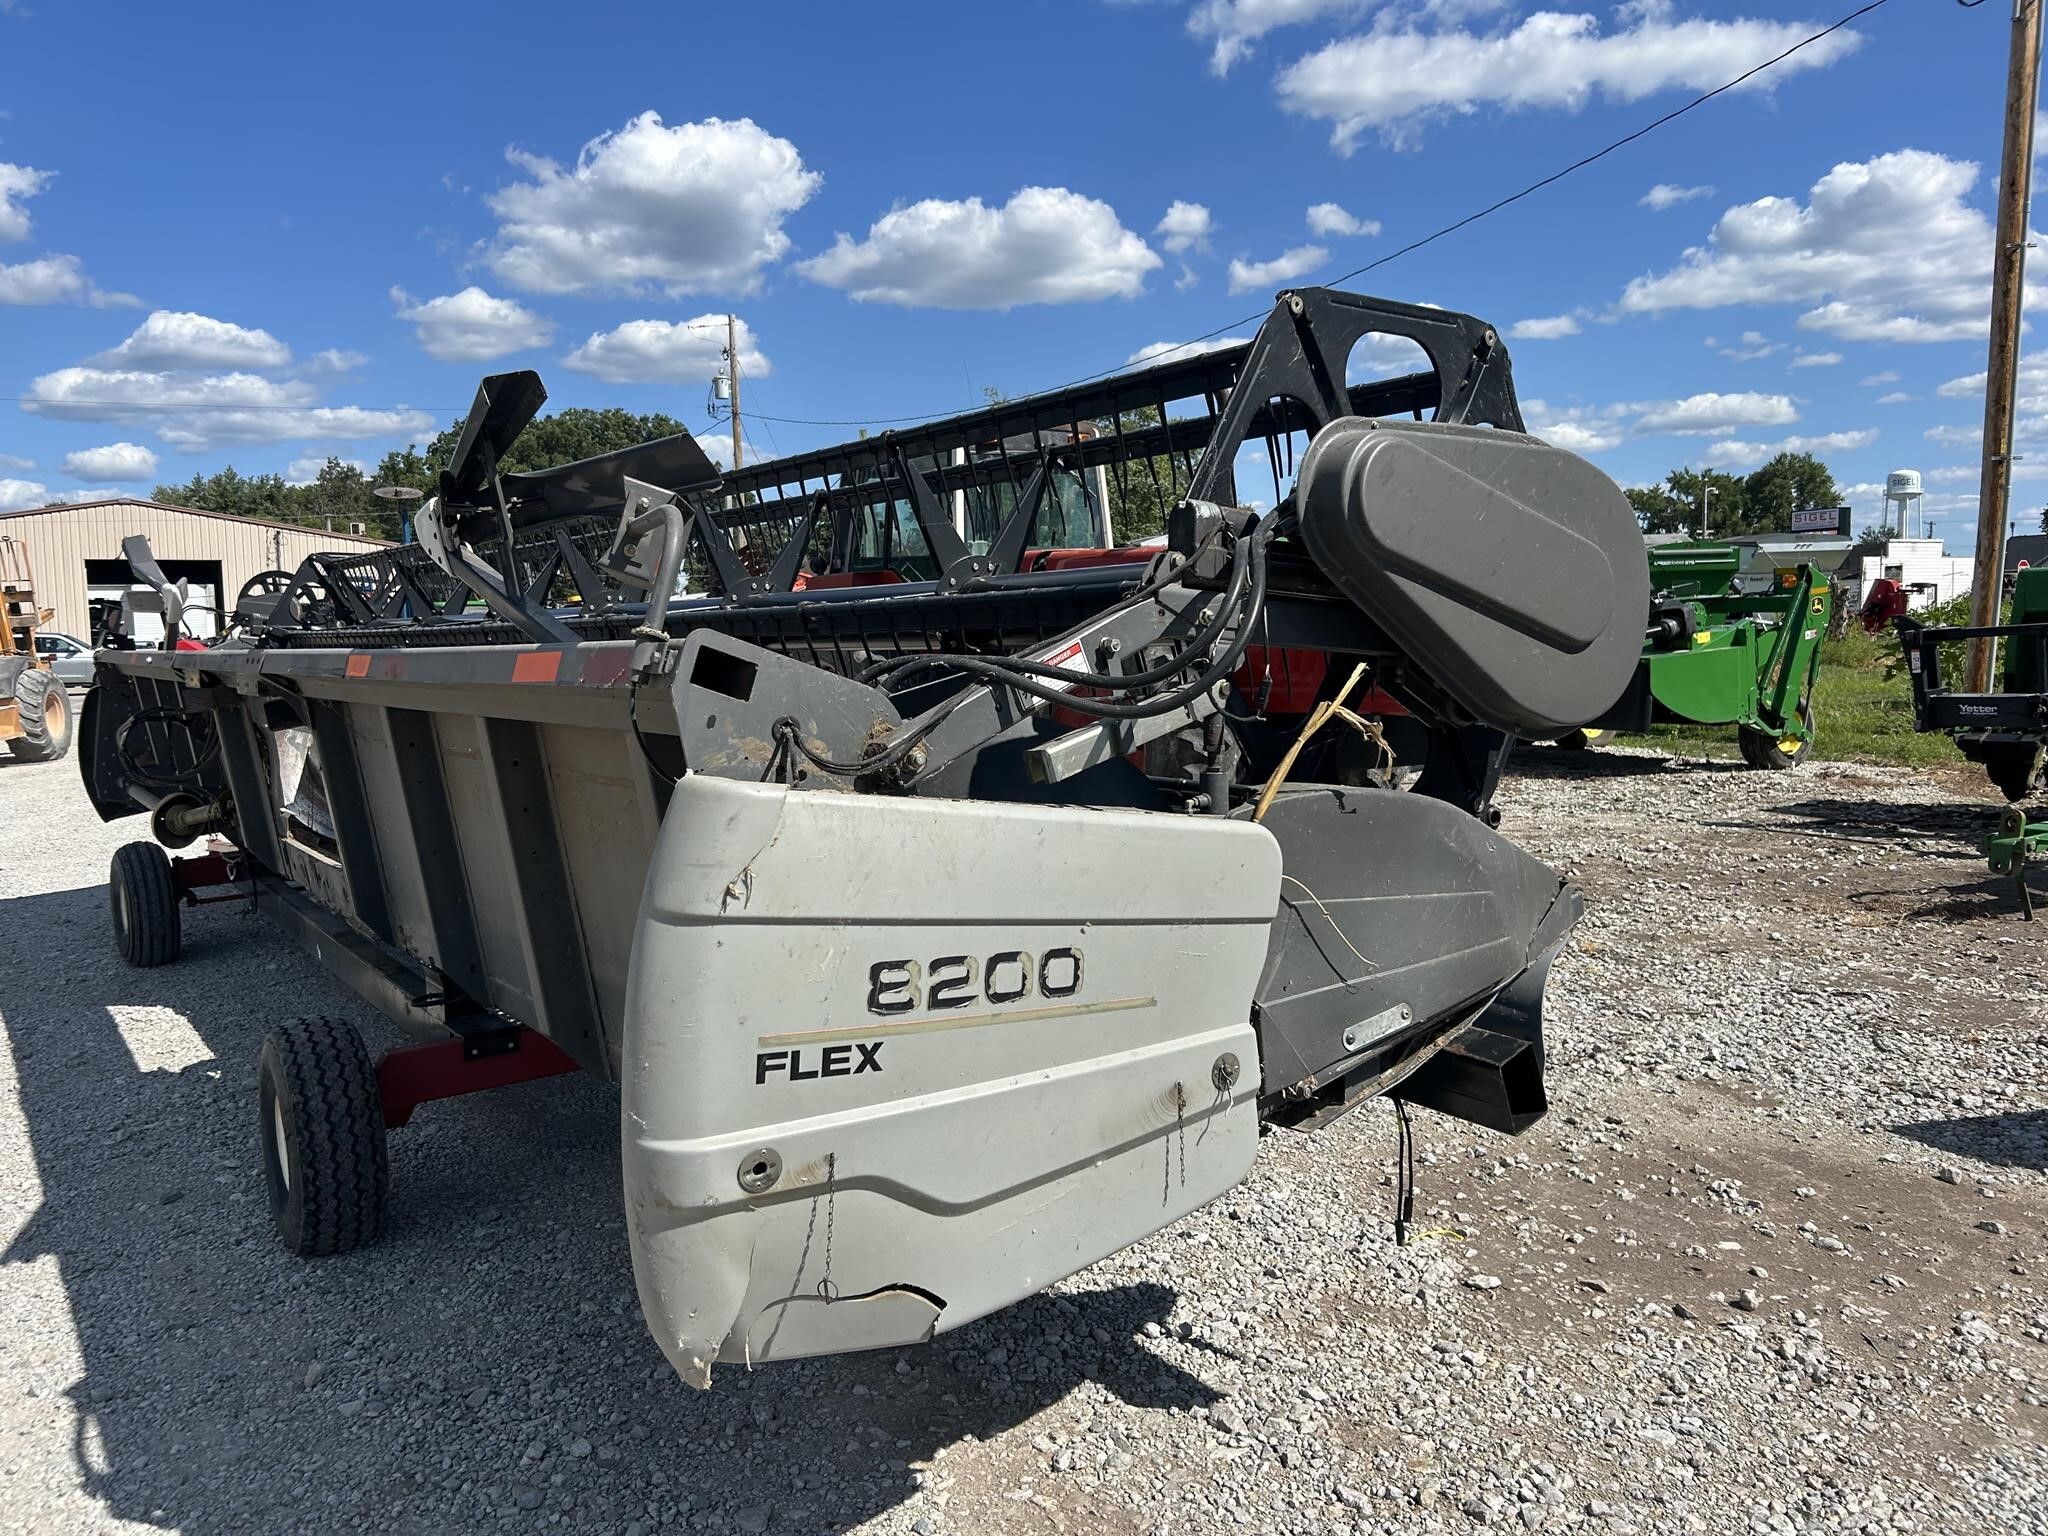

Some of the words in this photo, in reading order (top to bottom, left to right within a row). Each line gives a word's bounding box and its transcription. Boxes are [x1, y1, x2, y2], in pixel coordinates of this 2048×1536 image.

[1892, 478, 1916, 487] SIGEL
[1794, 511, 1837, 523] SIGEL
[1959, 704, 1998, 712] Yetter
[867, 947, 1085, 1016] 8200
[755, 1041, 885, 1085] FLEX
